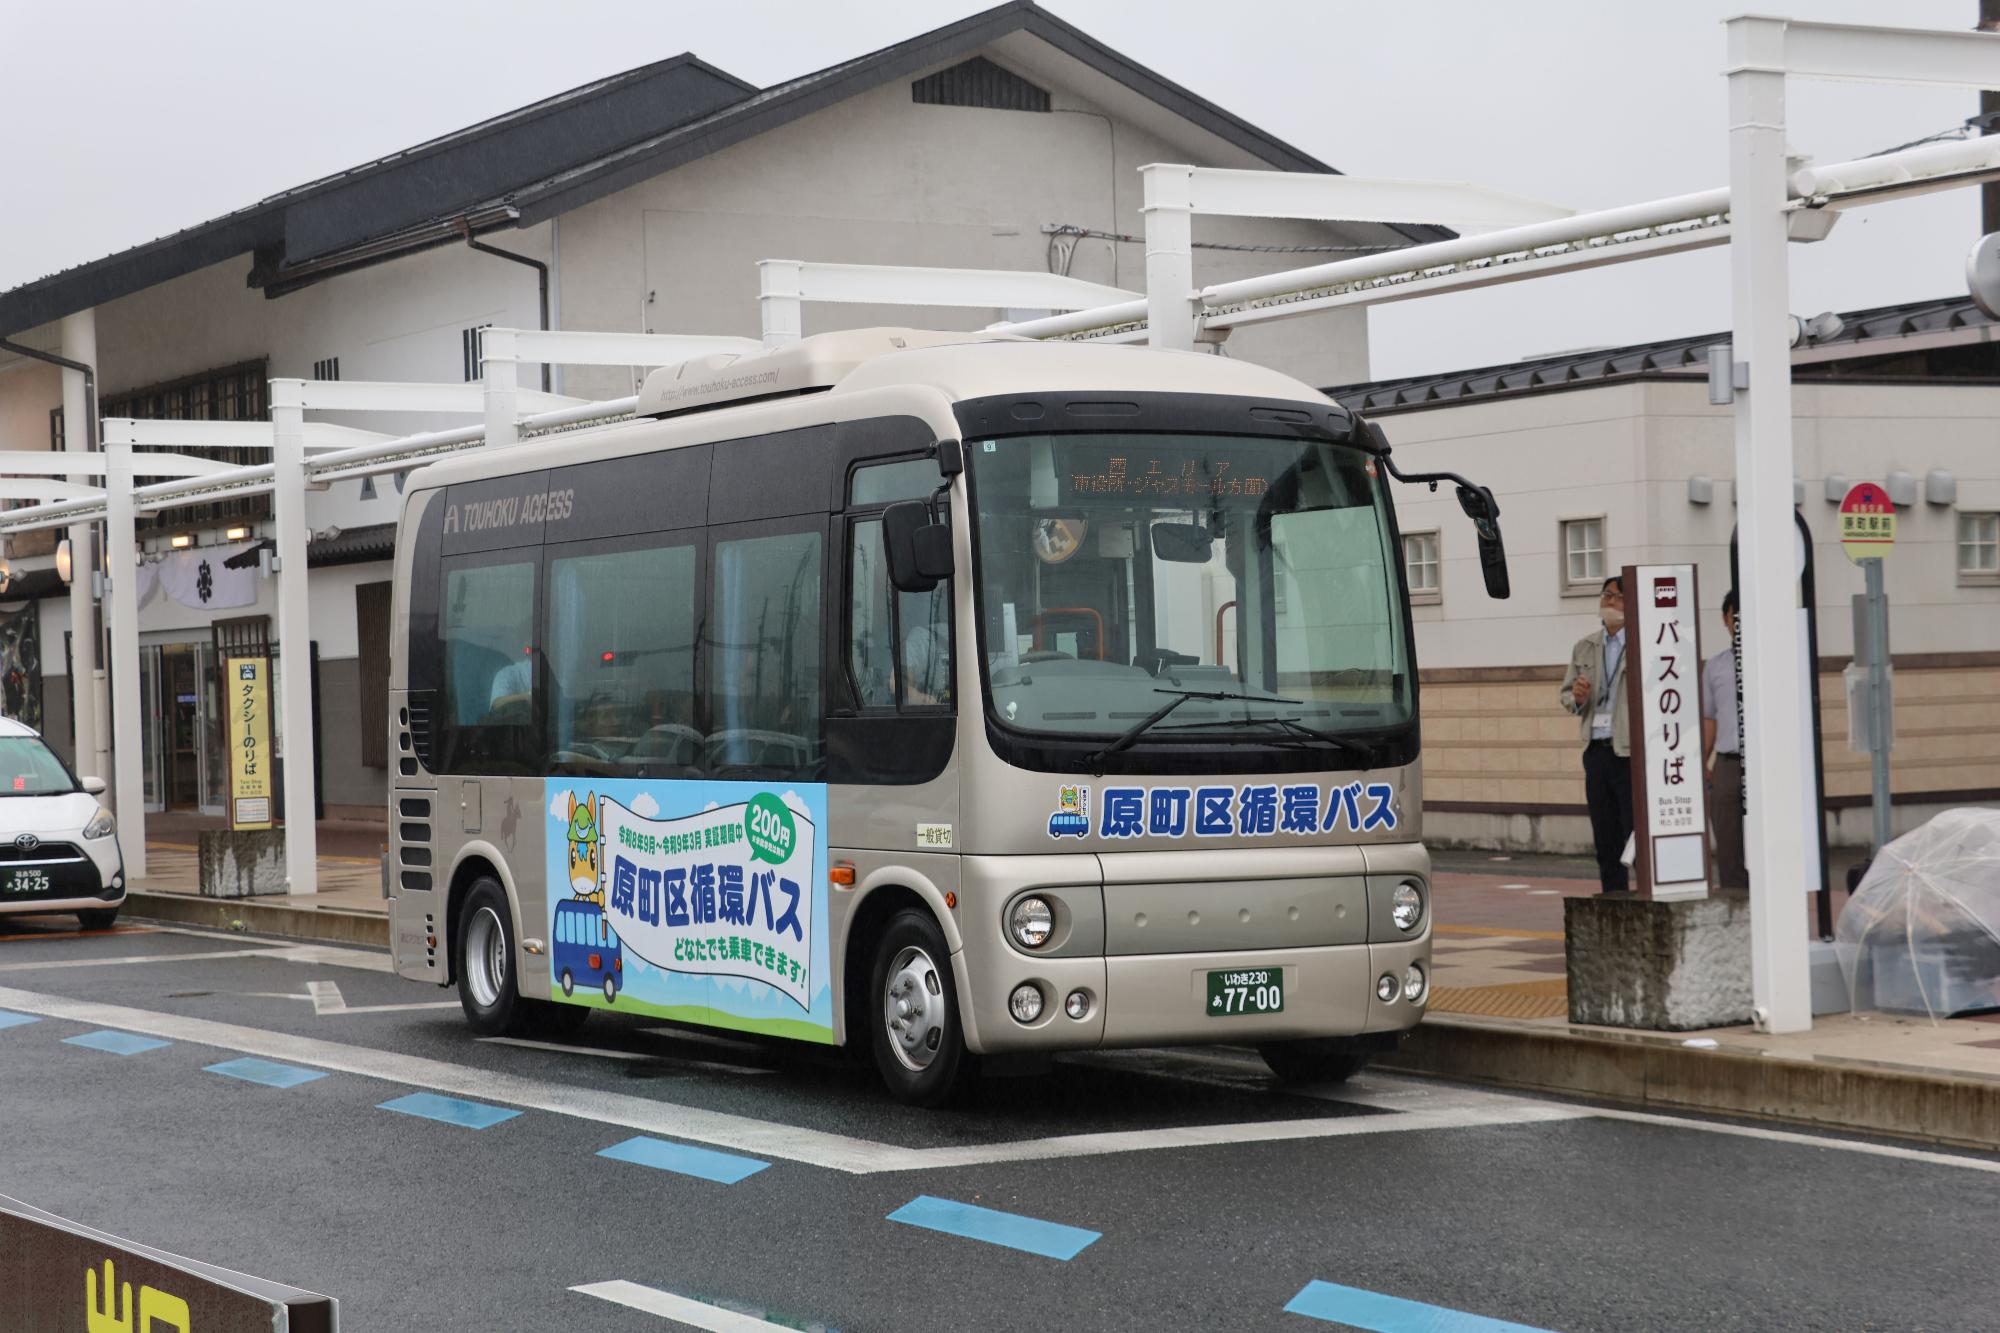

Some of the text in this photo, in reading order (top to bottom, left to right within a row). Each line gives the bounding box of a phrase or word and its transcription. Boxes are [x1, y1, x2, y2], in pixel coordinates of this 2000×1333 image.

[660, 368, 780, 401] http://www.touhoku-access.com/
[463, 495, 518, 532] TOUHOKU
[519, 489, 574, 523] ACCESS
[1844, 517, 1891, 530] 原町駅前
[1655, 620, 1685, 786] バスのりば
[241, 683, 257, 776] タクシーのりば
[1100, 782, 1397, 837] 原町区循環バス
[1658, 795, 1692, 806] Bus Stop
[704, 822, 743, 848] 実証期間中
[751, 804, 791, 848] 200円
[917, 827, 952, 844] 一般貸切
[14, 876, 50, 892] 34-25
[611, 854, 803, 942] 原町区循環バス
[1224, 971, 1268, 986] いわき230
[1212, 985, 1281, 1013] あ 77-00
